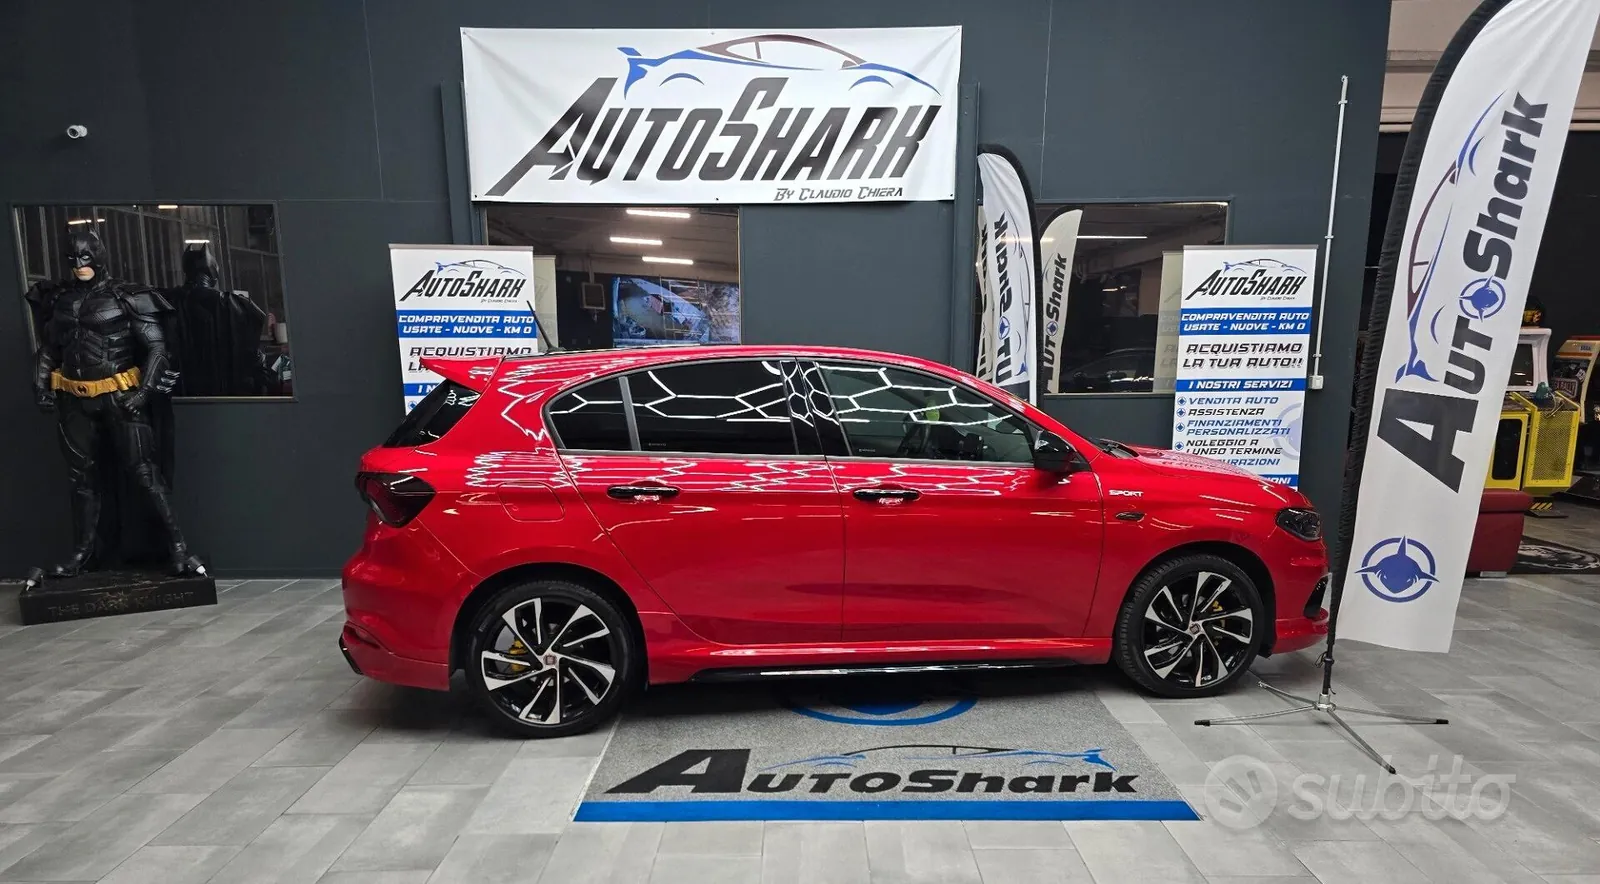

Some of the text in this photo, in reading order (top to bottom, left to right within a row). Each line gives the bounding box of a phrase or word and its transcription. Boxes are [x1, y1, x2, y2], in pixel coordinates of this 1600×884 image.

[485, 77, 942, 196] AUTOSHARK
[773, 186, 903, 201] BY CLAUDIO CHIERA
[399, 269, 527, 302] AUTOSHARK
[1185, 268, 1307, 301] AUTOSHARK
[398, 315, 535, 324] COMPRAVENDITA AUTO
[1181, 312, 1310, 322] COMPRAVENDITA AUTO
[402, 325, 443, 334] USATE
[452, 325, 494, 334] NUOVE
[503, 326, 521, 334] KM
[1183, 323, 1221, 331] USATE
[1229, 322, 1270, 331] NUOVE
[1278, 322, 1294, 330] KM
[410, 346, 532, 357] ACQUISTIAMO
[1186, 342, 1303, 355] ACQUISTIAMO
[1182, 357, 1303, 369] LA TUA AUTO!!
[1188, 380, 1293, 389] I NOSTRI SERVIZI
[1188, 396, 1279, 405] VENDITA AUTO
[1187, 407, 1266, 416] ASSISTENZA
[1186, 418, 1283, 428] FINANZIAMENTI
[1185, 427, 1291, 436] PERSONALIZZATI
[1186, 438, 1260, 447] NOLEGGIO A
[1229, 447, 1283, 455] TERMINE
[1108, 489, 1144, 497] SPORT
